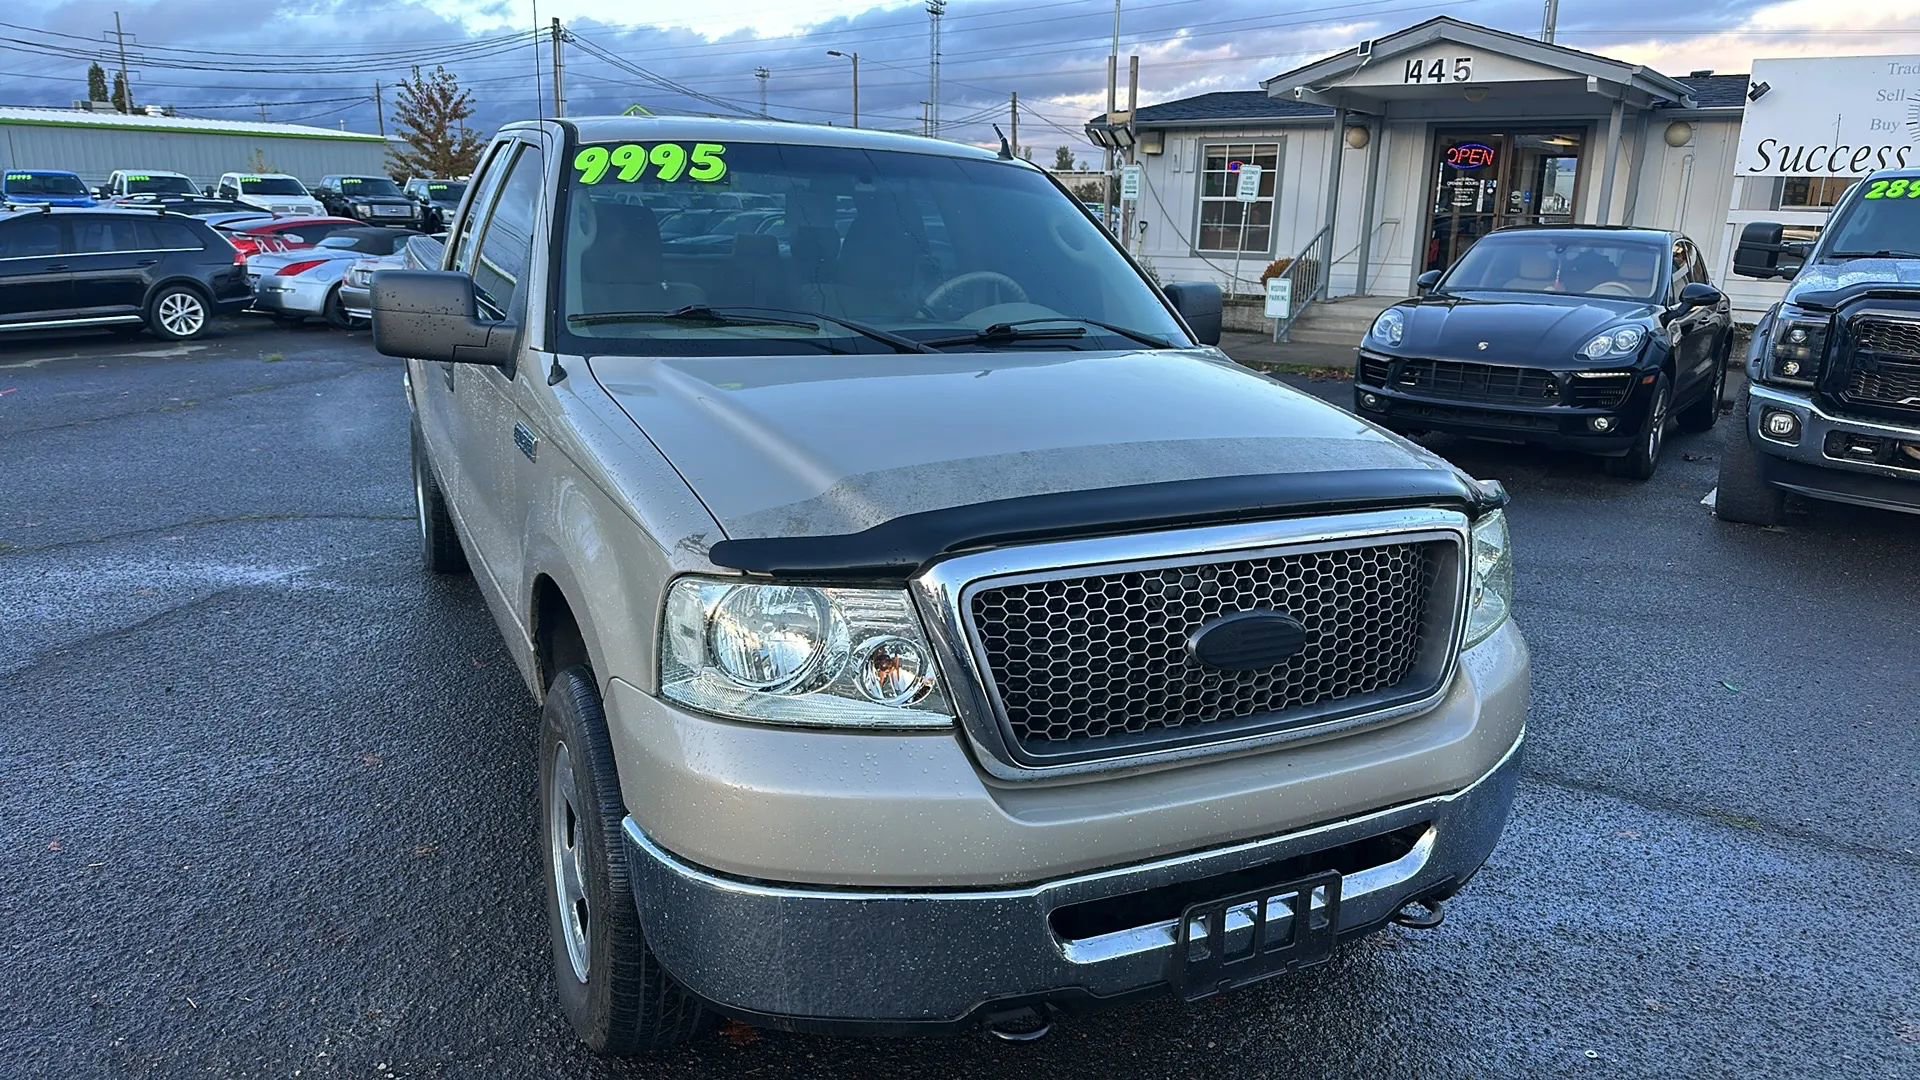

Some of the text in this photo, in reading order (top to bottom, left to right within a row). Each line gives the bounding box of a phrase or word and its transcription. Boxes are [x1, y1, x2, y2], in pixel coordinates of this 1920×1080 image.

[1404, 58, 1472, 83] 1445
[1876, 88, 1905, 102] Sell
[1870, 118, 1900, 134] Buy
[574, 143, 727, 185] 9995
[1447, 147, 1494, 166] OPEN
[1748, 138, 1912, 173] Success
